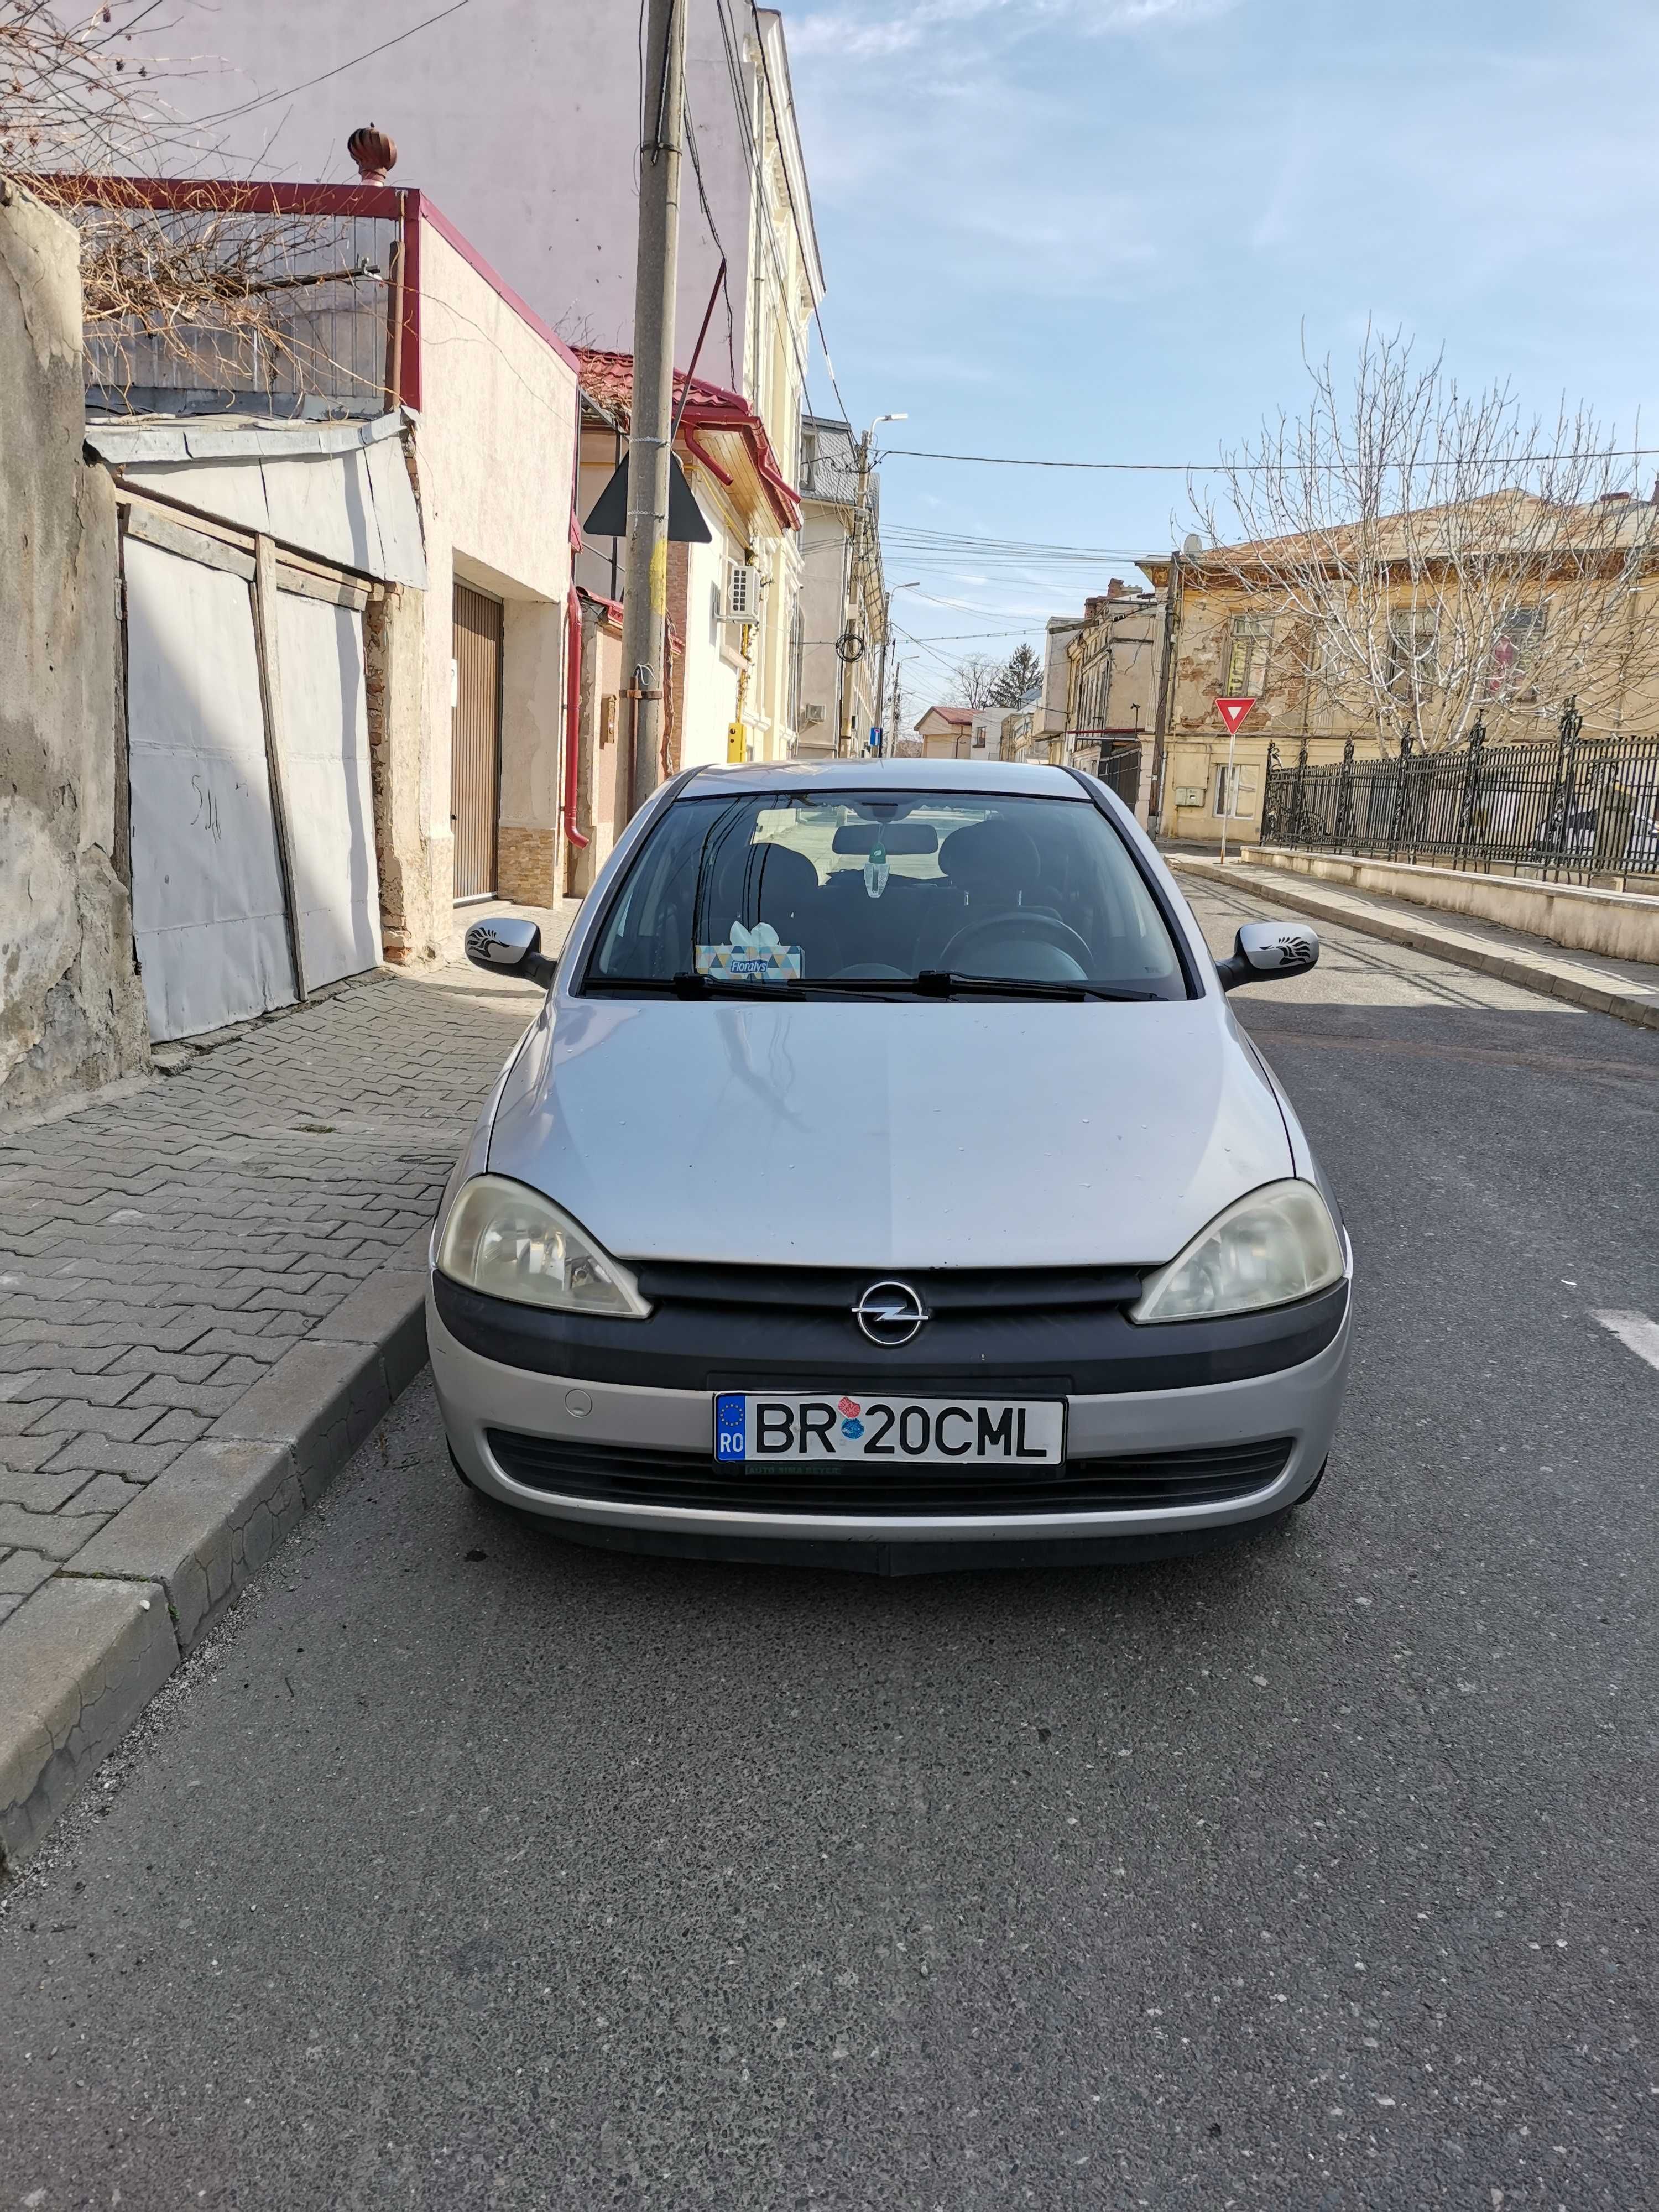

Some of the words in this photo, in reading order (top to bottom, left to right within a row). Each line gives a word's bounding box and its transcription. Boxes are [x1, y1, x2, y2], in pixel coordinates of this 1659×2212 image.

[732, 961, 766, 973] Floralys
[756, 1402, 837, 1453] BR
[720, 1433, 743, 1453] RO
